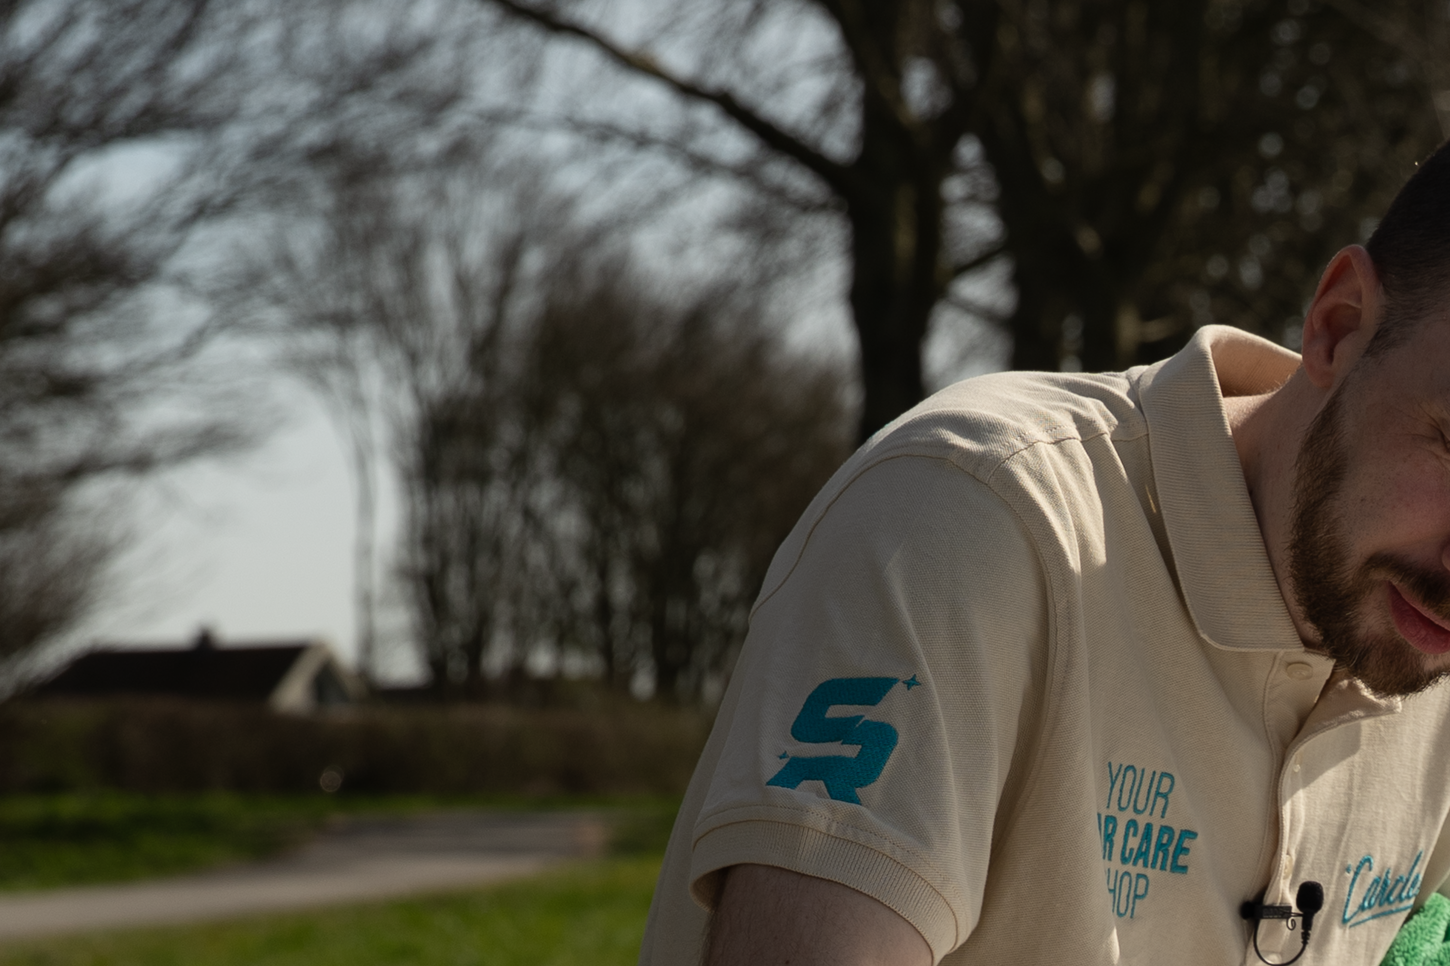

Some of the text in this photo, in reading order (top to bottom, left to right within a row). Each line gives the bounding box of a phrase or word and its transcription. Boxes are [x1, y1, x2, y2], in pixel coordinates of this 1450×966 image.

[1106, 761, 1175, 819] YOUR
[1097, 812, 1198, 875] R CARE
[1104, 867, 1150, 919] HOP
